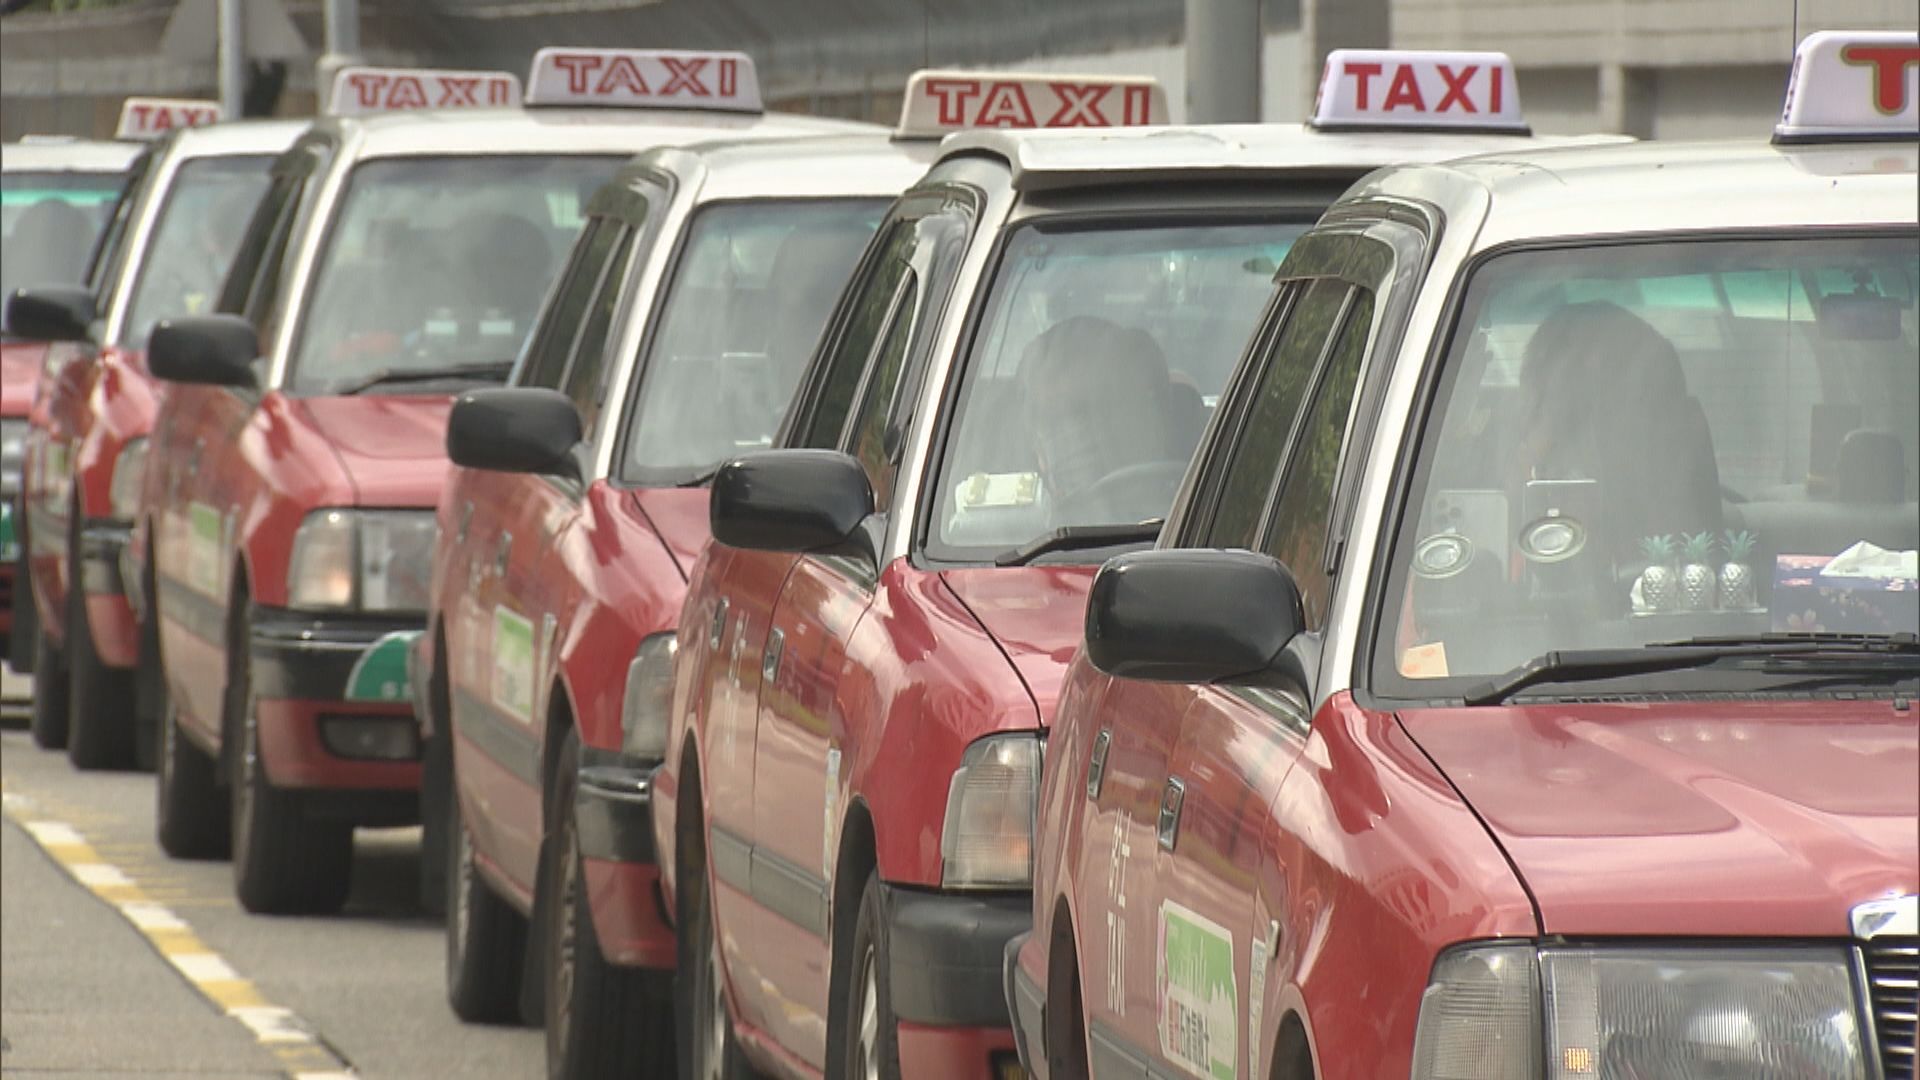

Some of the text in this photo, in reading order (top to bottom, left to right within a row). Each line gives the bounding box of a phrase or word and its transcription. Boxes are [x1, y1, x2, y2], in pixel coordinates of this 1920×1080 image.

[350, 73, 510, 109] TAXI
[553, 53, 738, 97] TAXI
[1344, 63, 1503, 113] TAXI
[132, 104, 218, 130] TAXI
[925, 79, 1151, 128] TAXI
[1107, 910, 1126, 1017] TAXI
